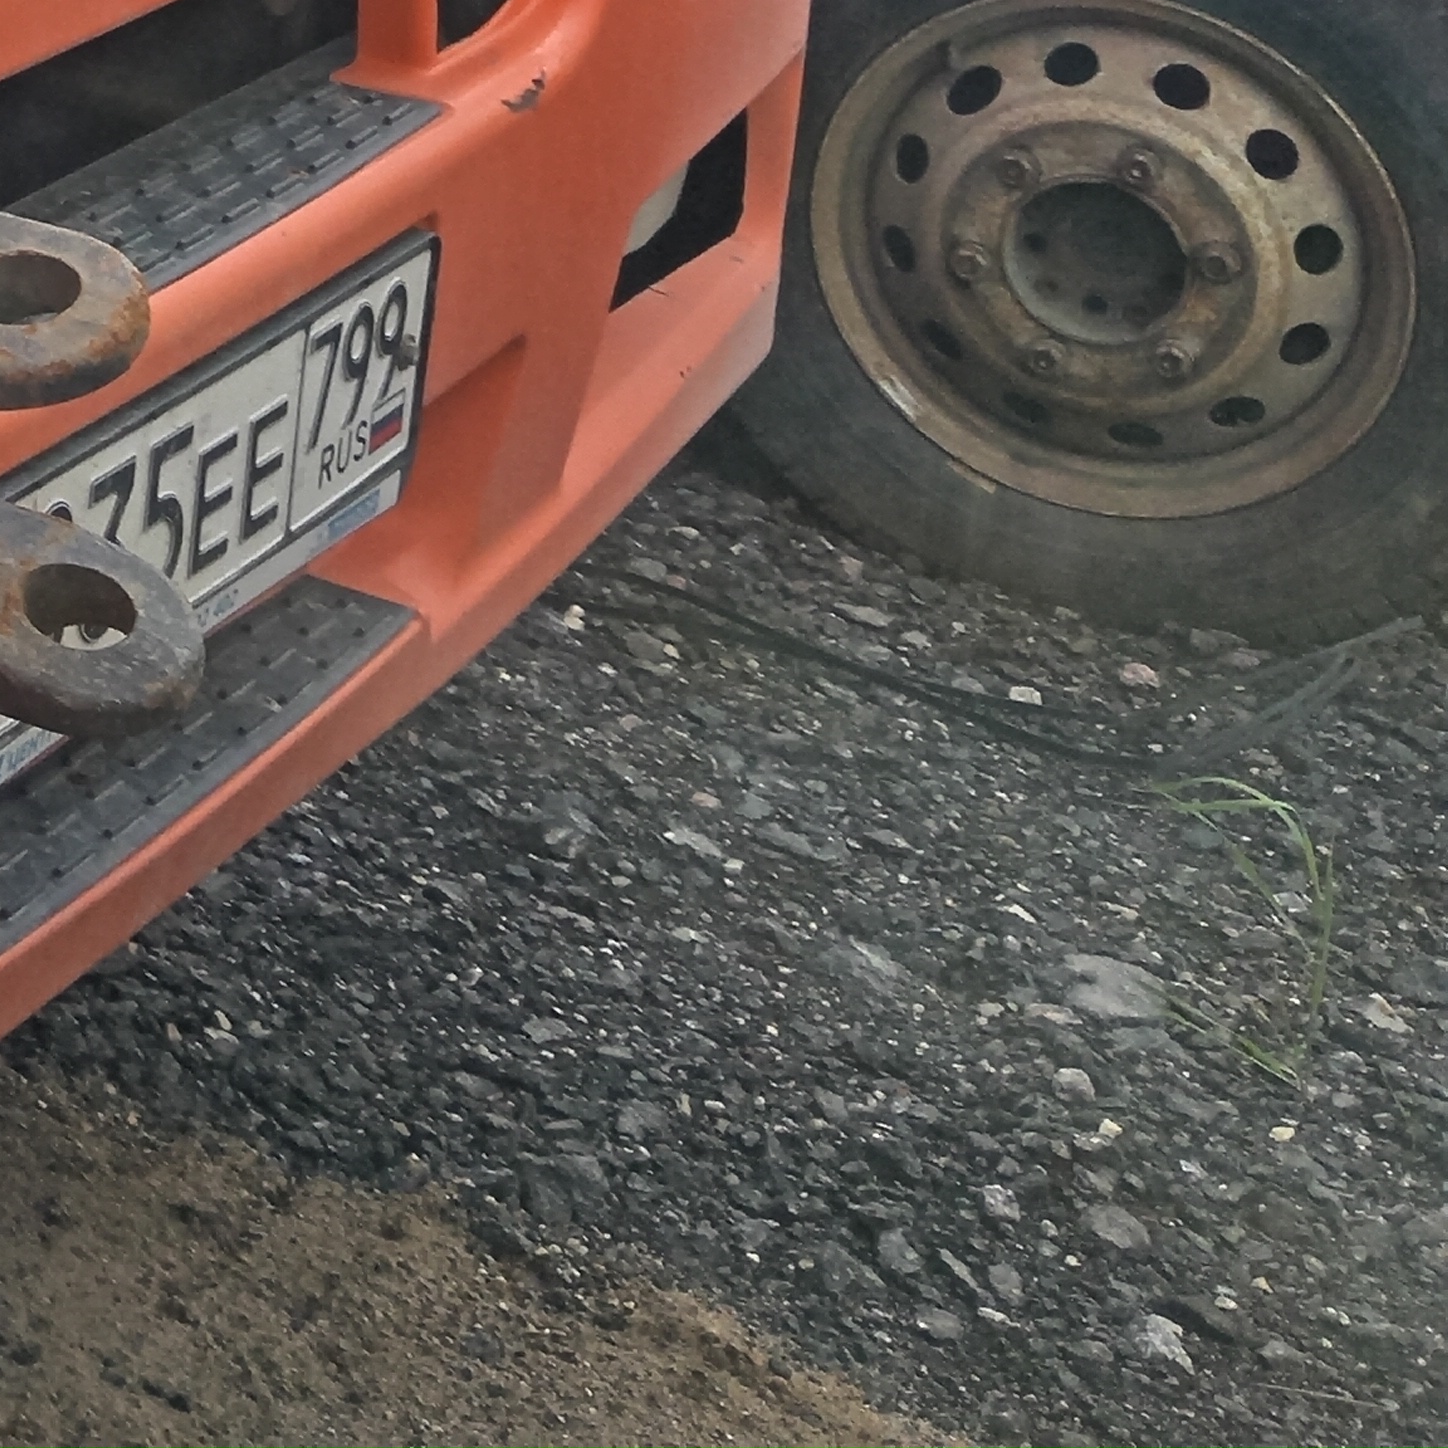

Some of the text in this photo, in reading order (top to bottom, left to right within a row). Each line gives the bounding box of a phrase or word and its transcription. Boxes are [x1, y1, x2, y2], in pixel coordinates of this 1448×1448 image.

[41, 278, 409, 649] 35EE 799
[317, 419, 369, 490] RUS
